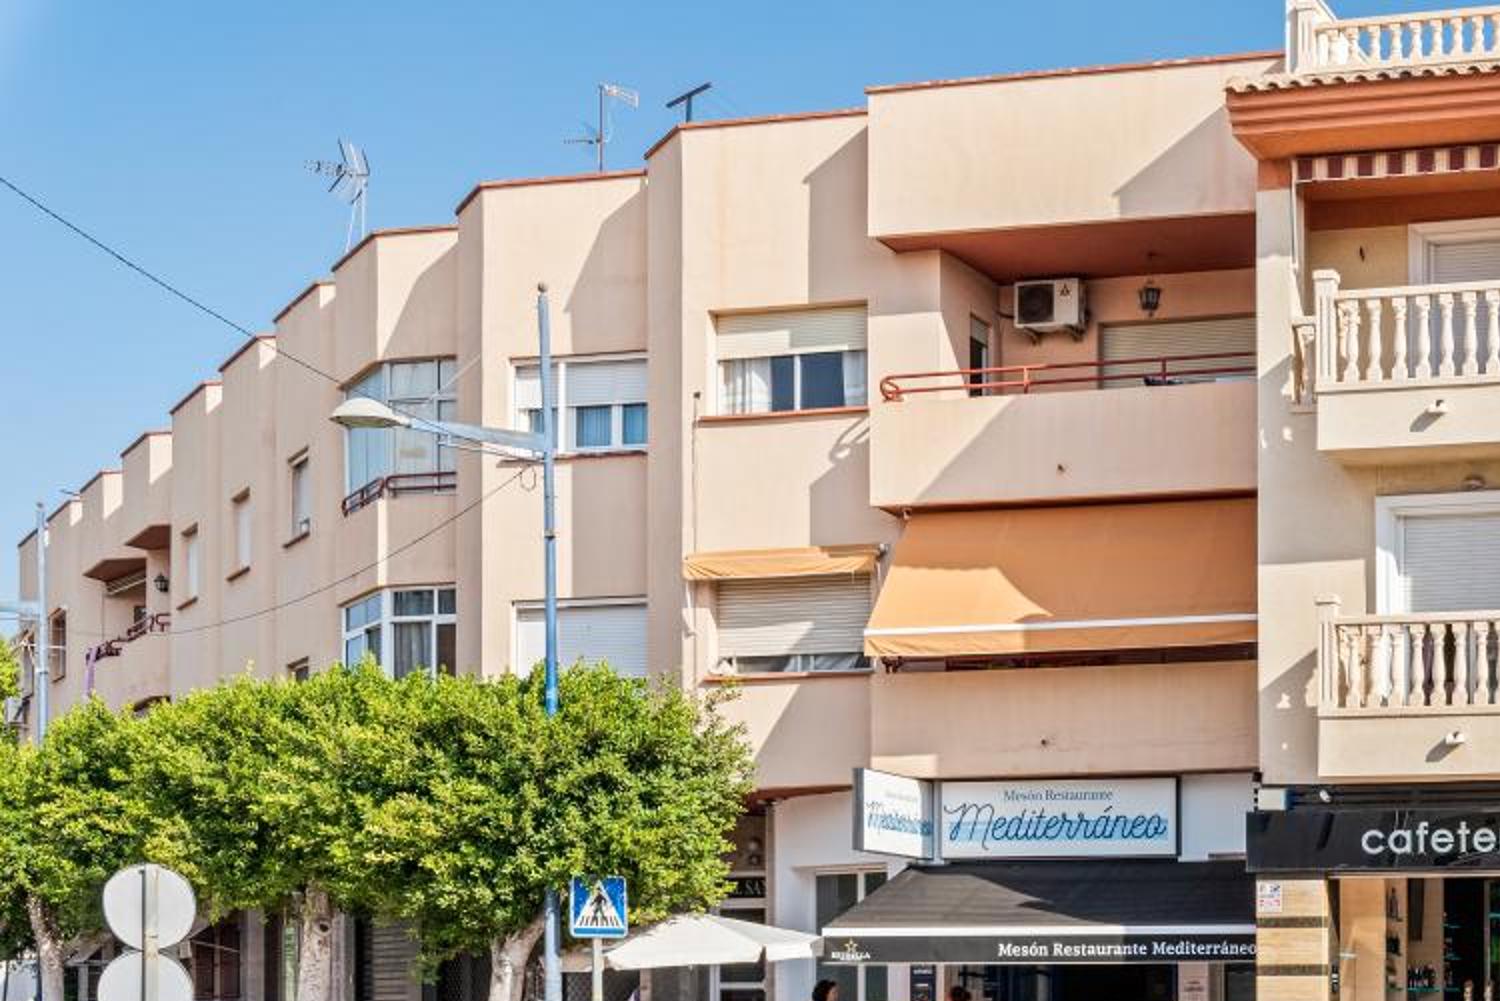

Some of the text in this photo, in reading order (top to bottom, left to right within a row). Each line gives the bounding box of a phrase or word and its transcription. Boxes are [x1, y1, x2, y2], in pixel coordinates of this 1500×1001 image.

[943, 802, 1167, 850] Mediterráneo
[998, 941, 1257, 957] Mesón Restaurante Mediterráneo
